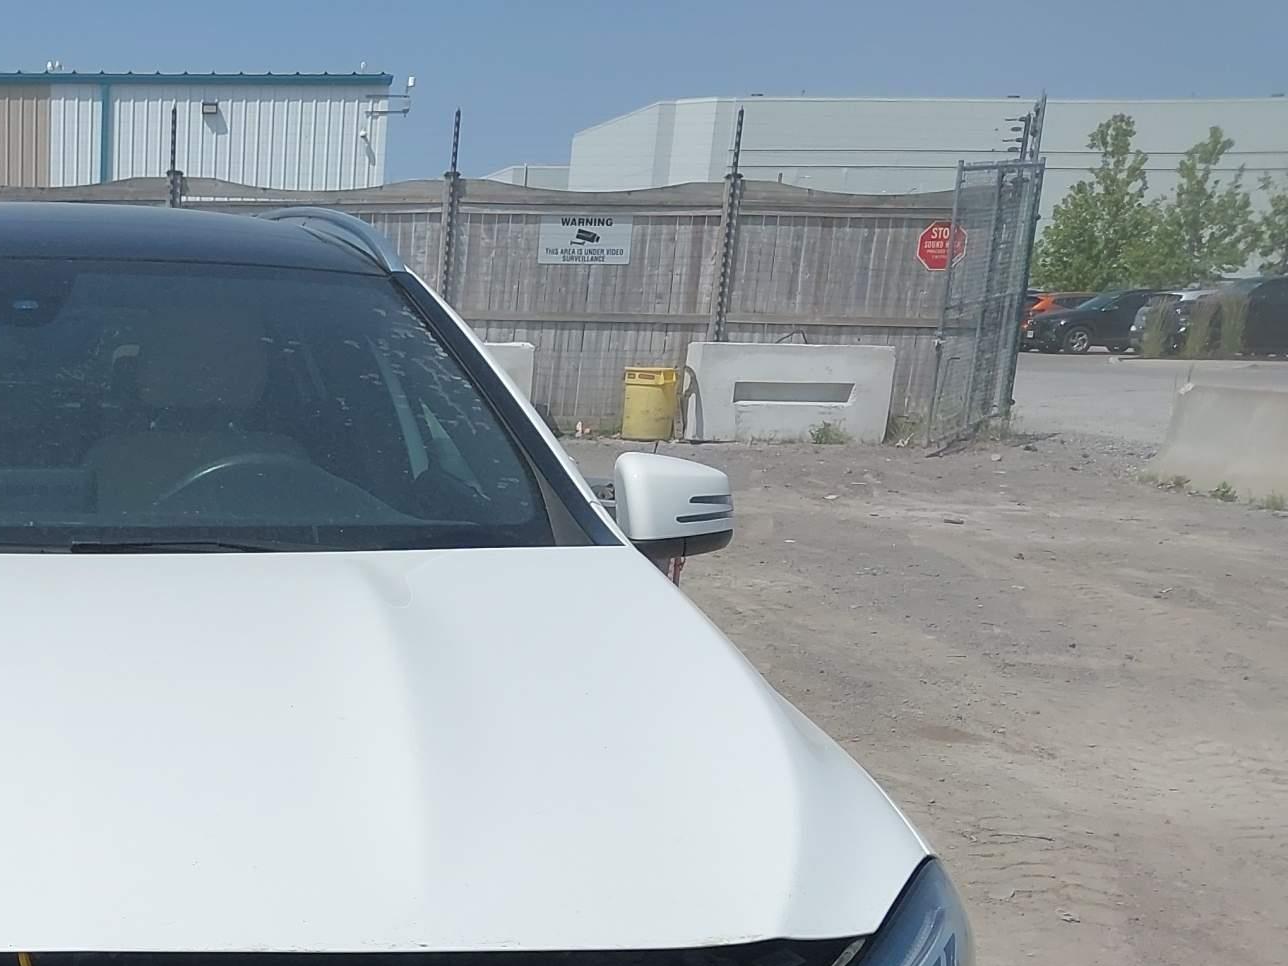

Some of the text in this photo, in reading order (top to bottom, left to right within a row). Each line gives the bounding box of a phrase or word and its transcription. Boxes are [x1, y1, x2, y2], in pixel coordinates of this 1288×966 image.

[561, 217, 613, 226] WARNING
[931, 227, 958, 239] STO
[606, 248, 624, 256] VIDEO
